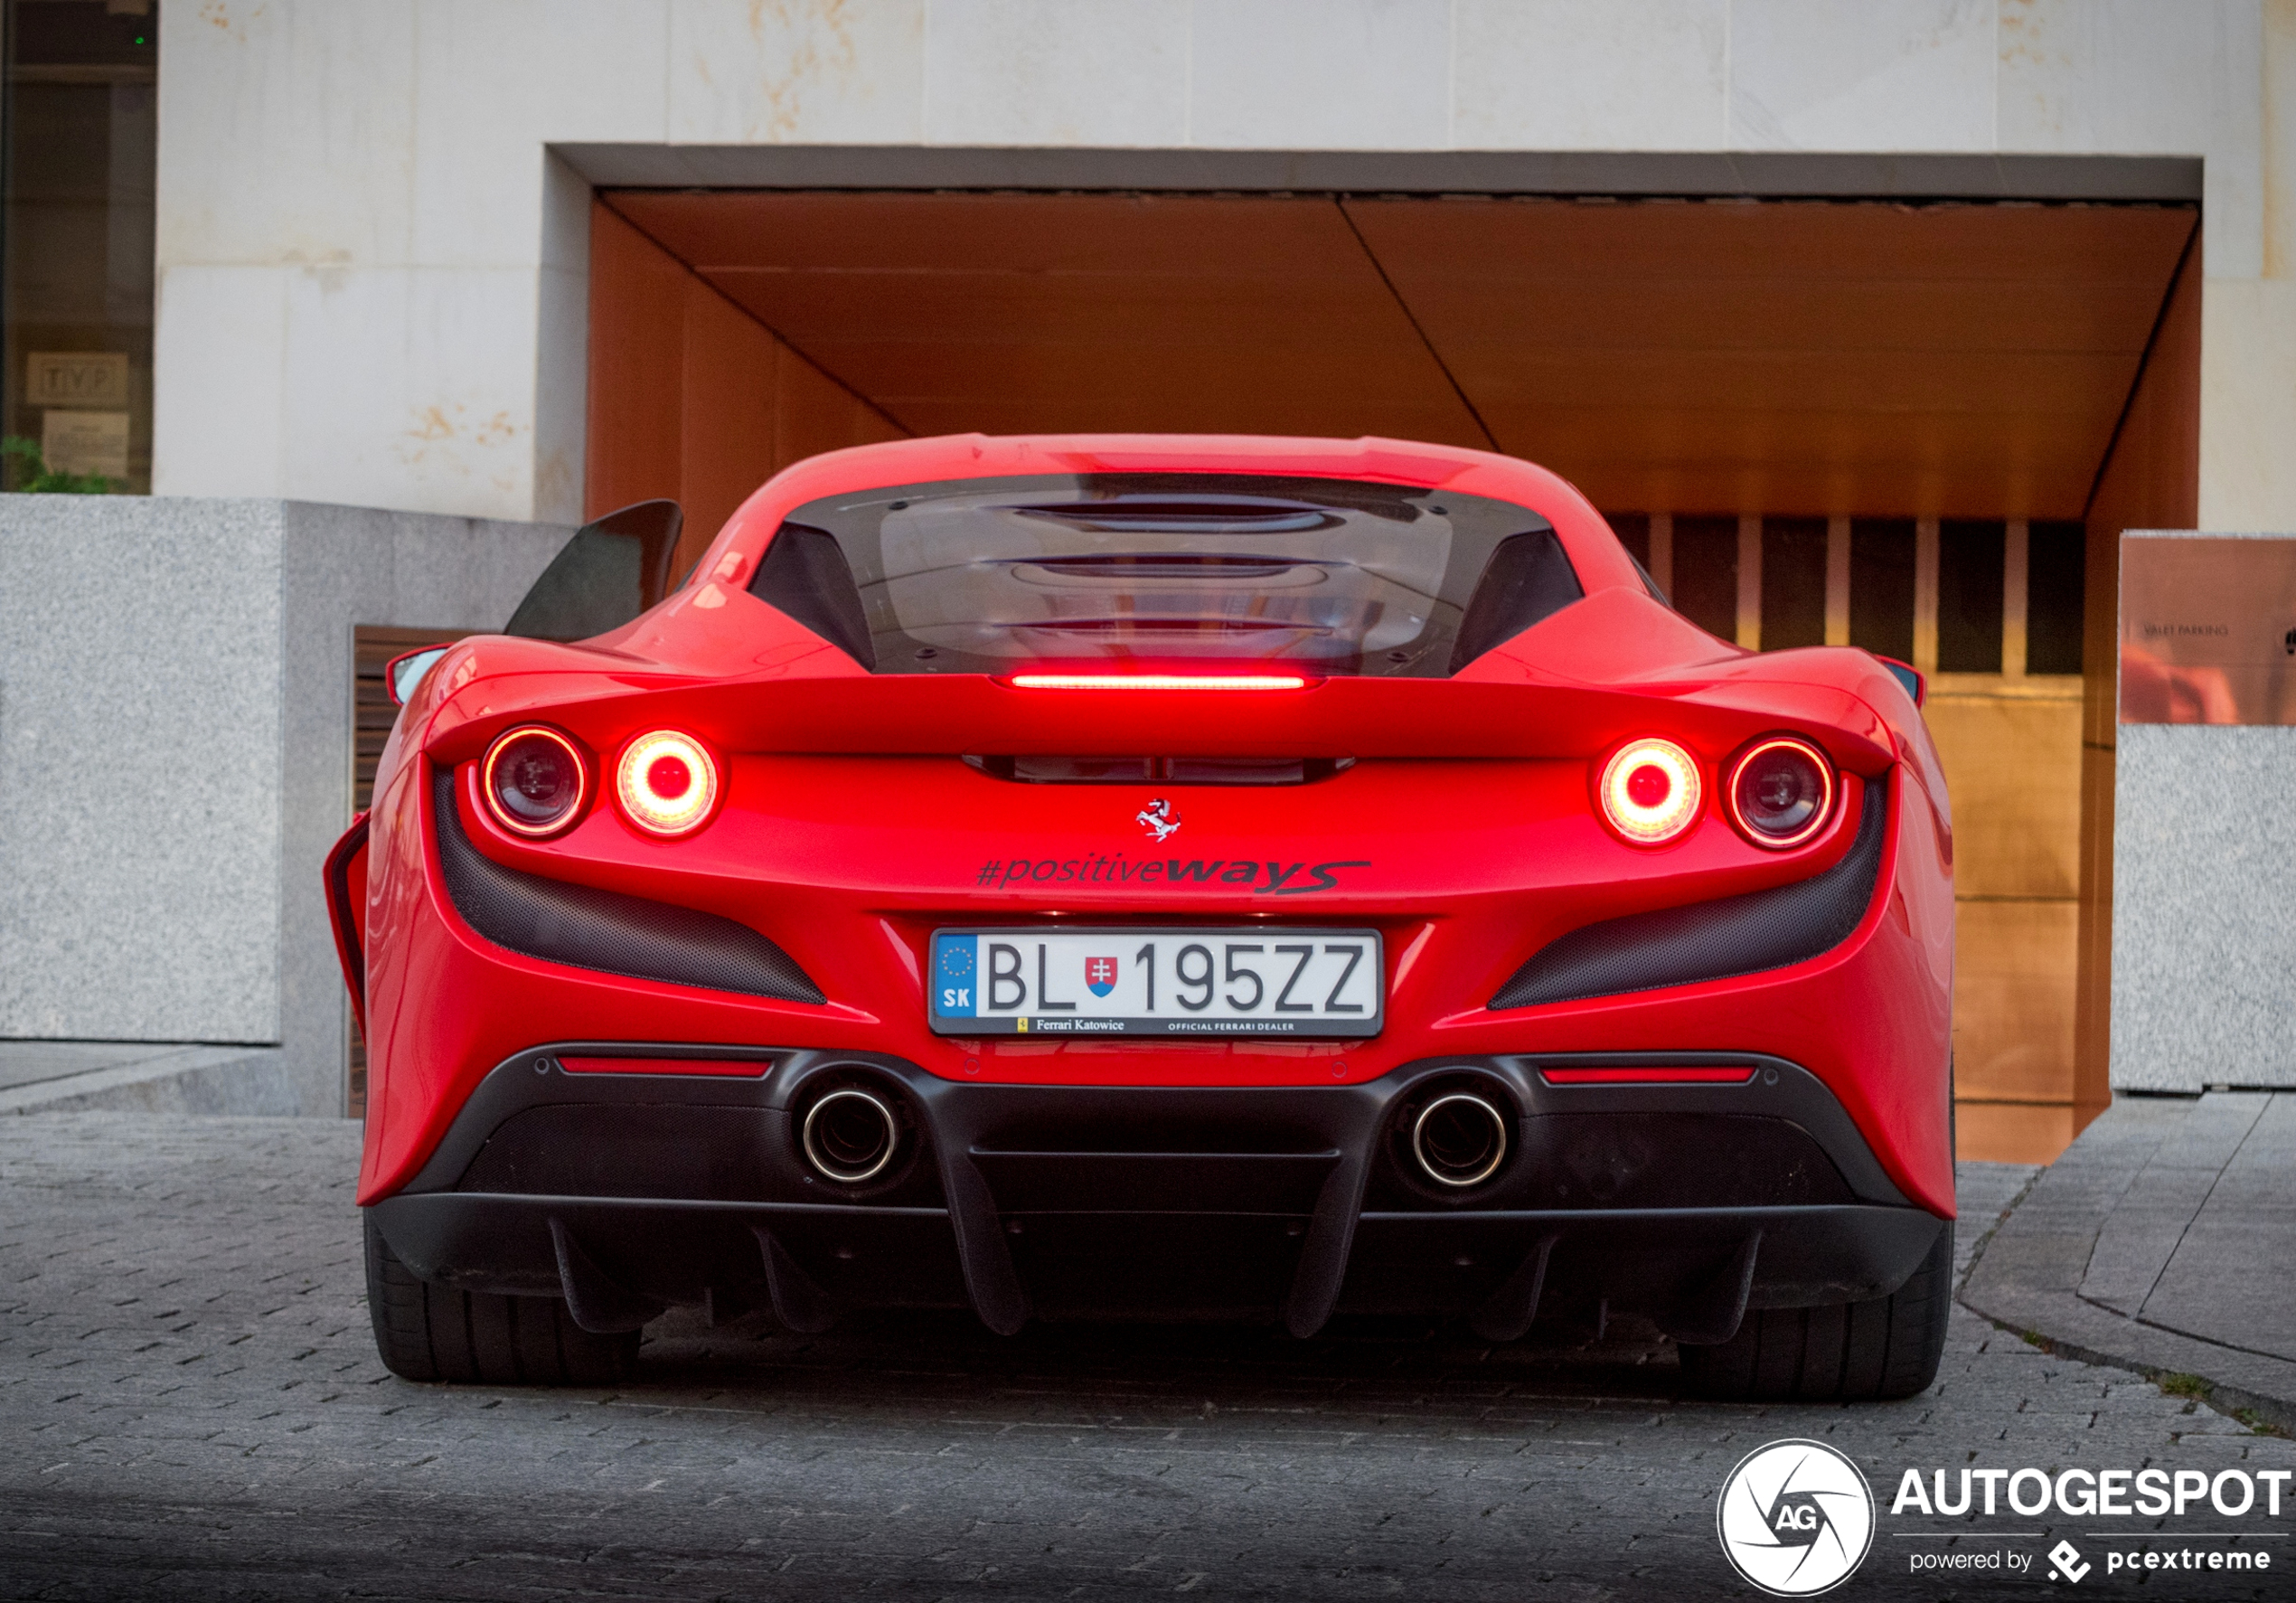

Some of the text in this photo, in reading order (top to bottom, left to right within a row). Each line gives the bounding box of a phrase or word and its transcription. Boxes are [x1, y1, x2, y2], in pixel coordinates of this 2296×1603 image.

[2143, 624, 2229, 636] VALET PARKING
[977, 853, 1371, 895] #positiveways
[989, 944, 1363, 1012] BL 195ZZ
[944, 989, 970, 1007] SK
[1037, 1019, 1124, 1031] Ferrari Katowice
[1168, 1023, 1294, 1031] OFFICIAL FERRARI DEALER
